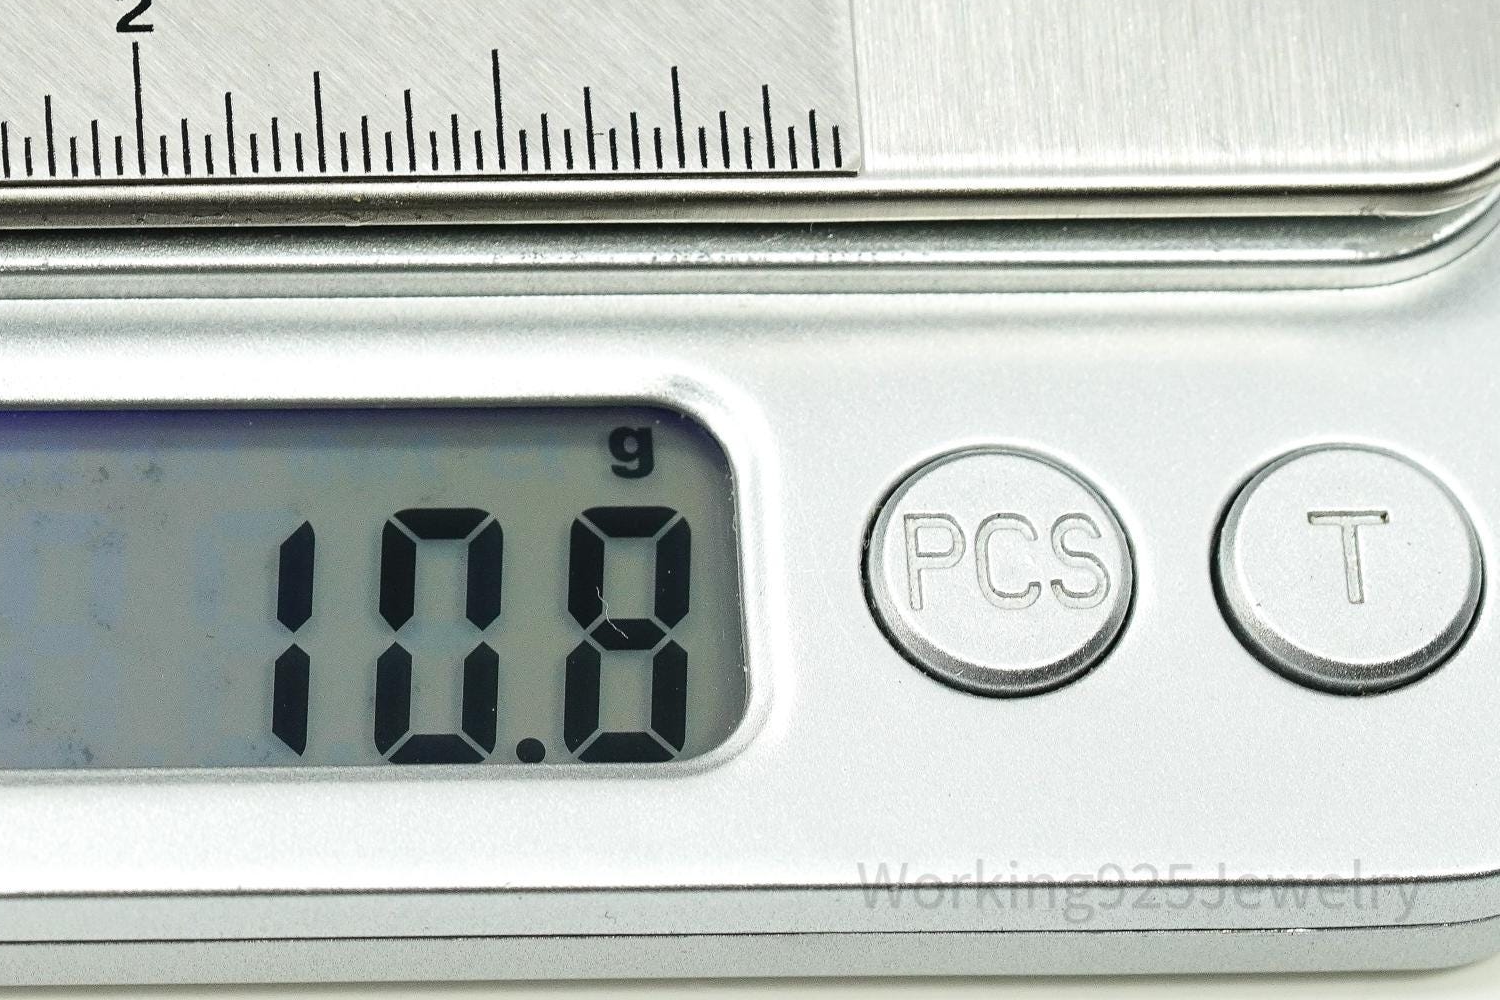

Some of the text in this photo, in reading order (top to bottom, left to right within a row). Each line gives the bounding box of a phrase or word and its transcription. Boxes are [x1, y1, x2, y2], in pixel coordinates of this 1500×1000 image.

[607, 425, 656, 479] g
[902, 511, 1111, 611] PCS
[1306, 509, 1390, 606] T
[271, 506, 692, 764] 10.8
